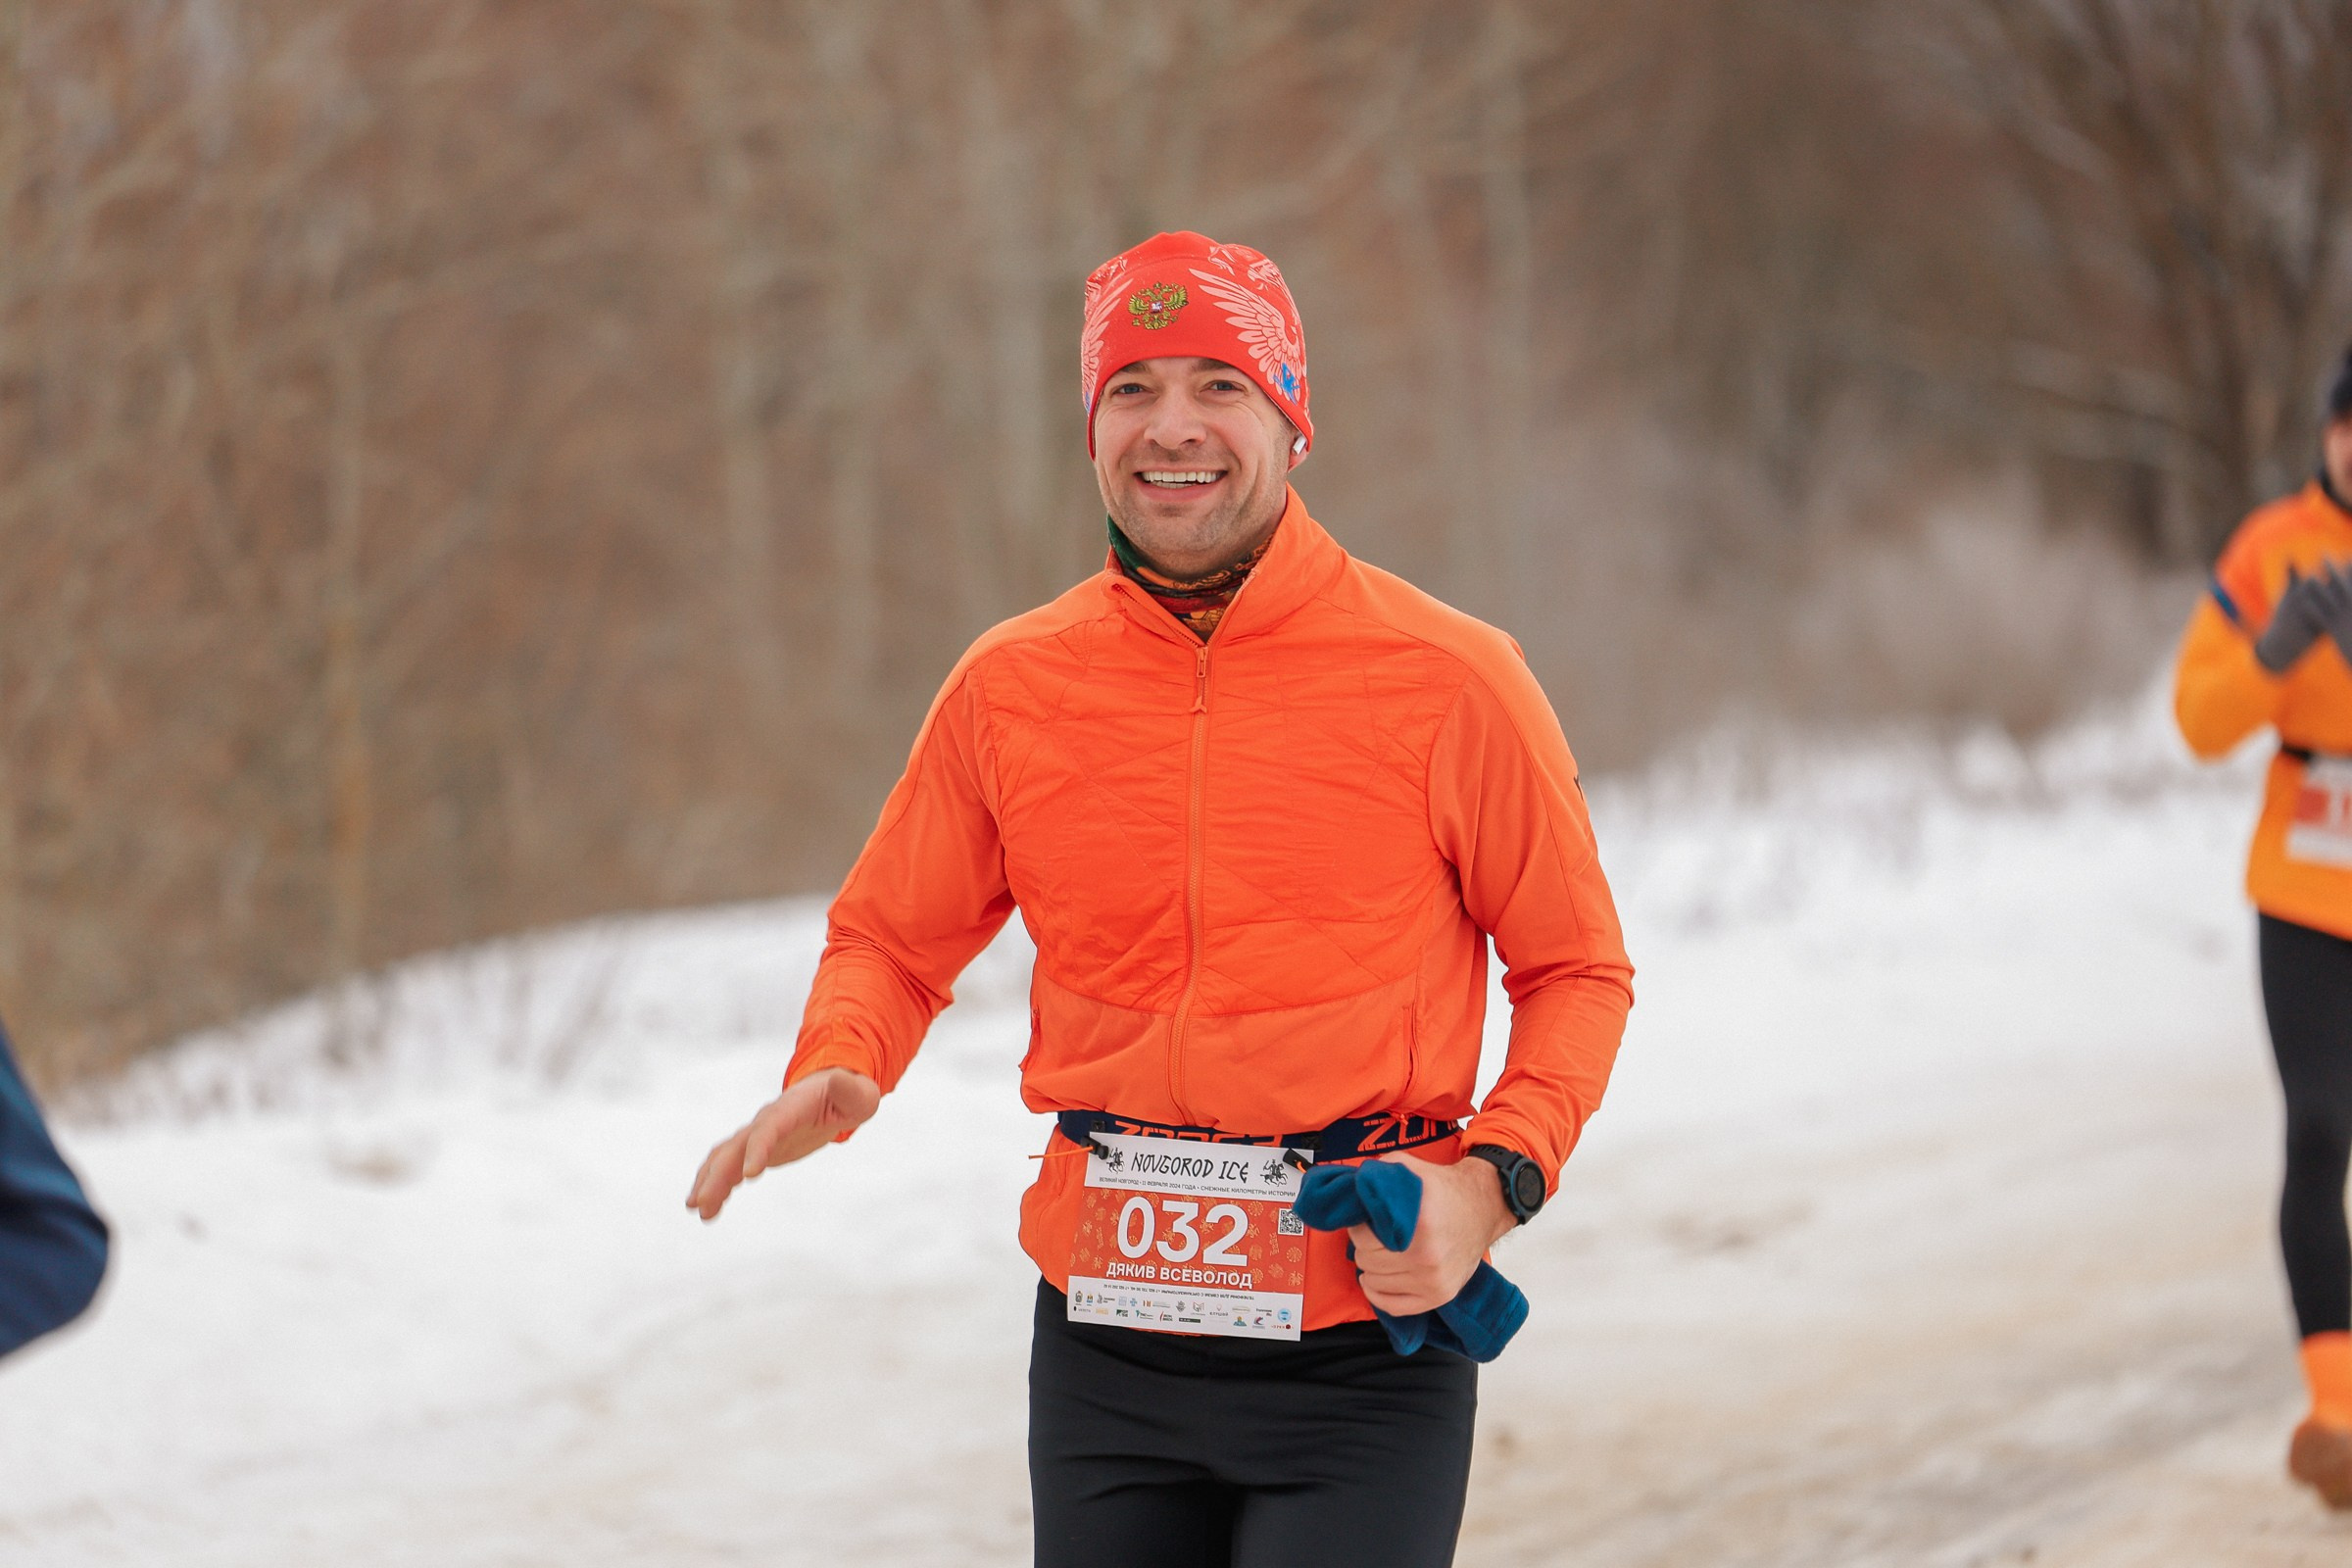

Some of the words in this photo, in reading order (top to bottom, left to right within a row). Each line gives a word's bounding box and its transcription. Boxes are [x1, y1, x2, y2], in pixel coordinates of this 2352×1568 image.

[1131, 1152, 1214, 1179] NOVGOROD
[1218, 1160, 1250, 1184] ICE
[1231, 1187, 1267, 1196] КИЛОМЕТРЫ
[1117, 1196, 1249, 1267] 032
[1105, 1261, 1155, 1279] ДЯКИВ
[1159, 1264, 1253, 1290] ВСЕВОЛОД
